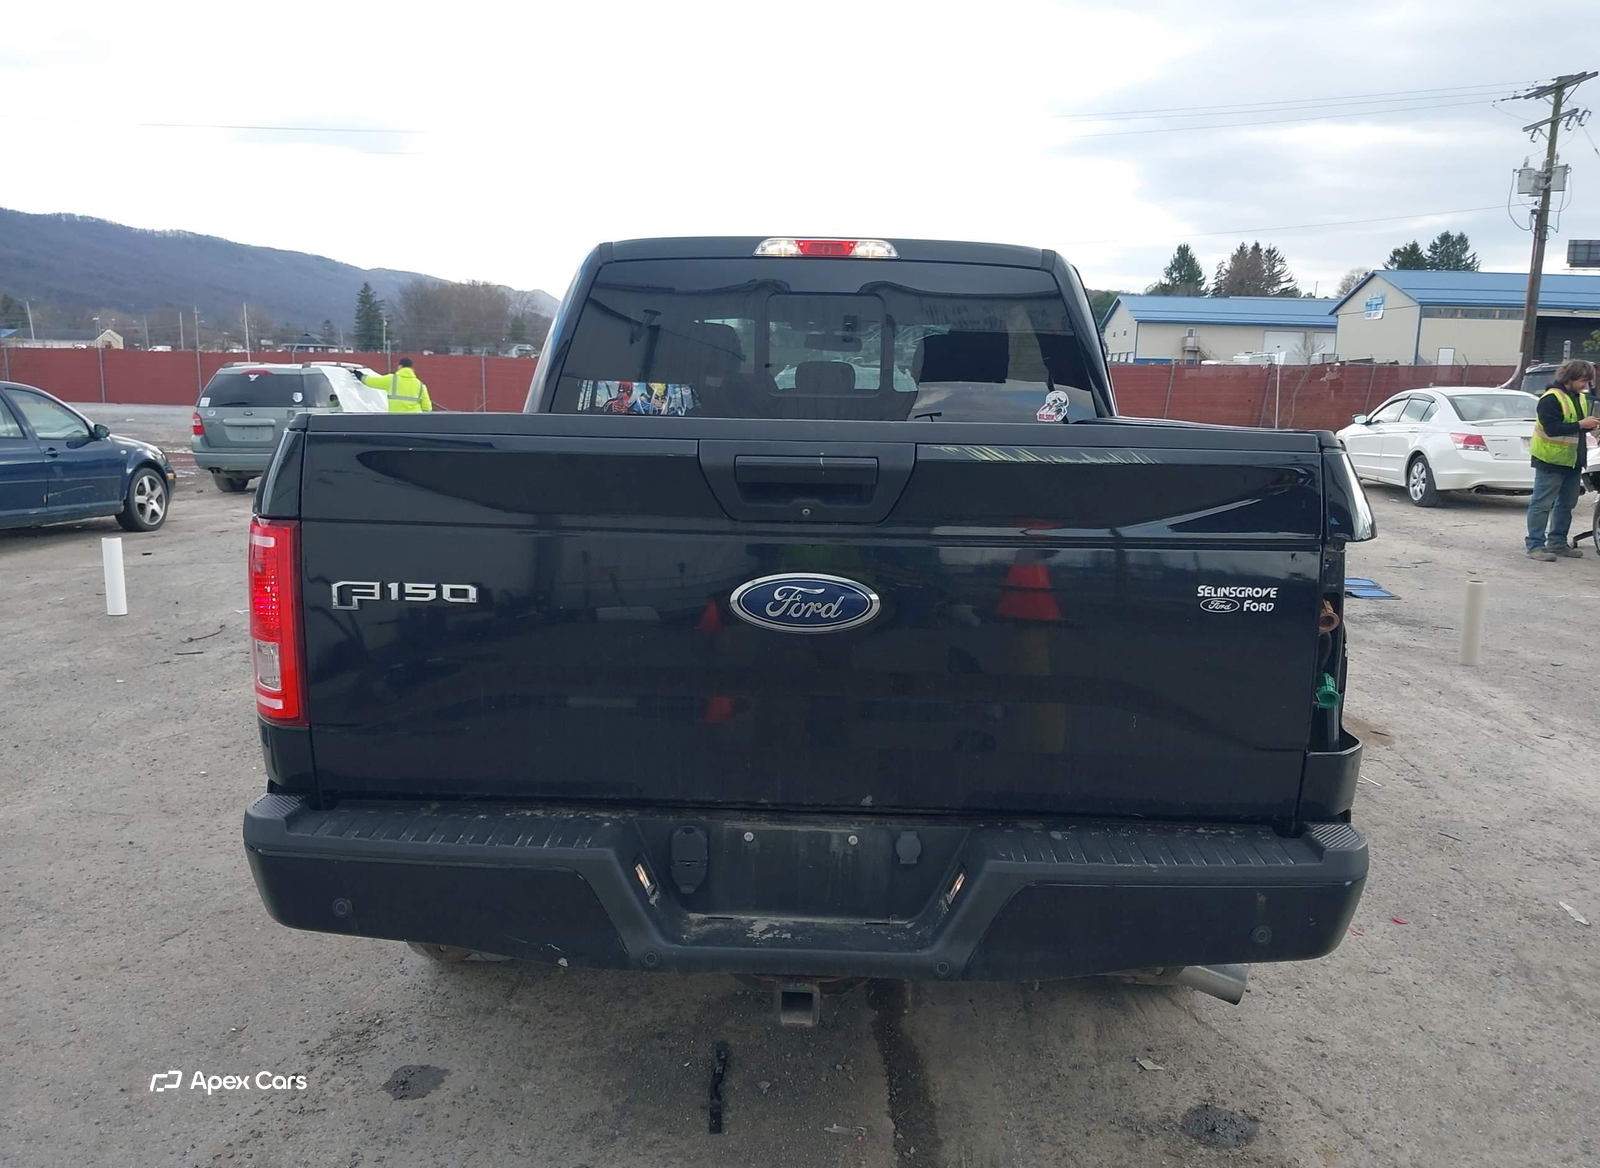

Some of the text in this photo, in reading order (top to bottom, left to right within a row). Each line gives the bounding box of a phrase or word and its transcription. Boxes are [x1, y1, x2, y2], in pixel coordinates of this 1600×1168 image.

[331, 581, 477, 610] F150
[765, 586, 845, 618] Ford
[1197, 585, 1278, 598] SELINSGROVE
[1208, 600, 1232, 610] Ford
